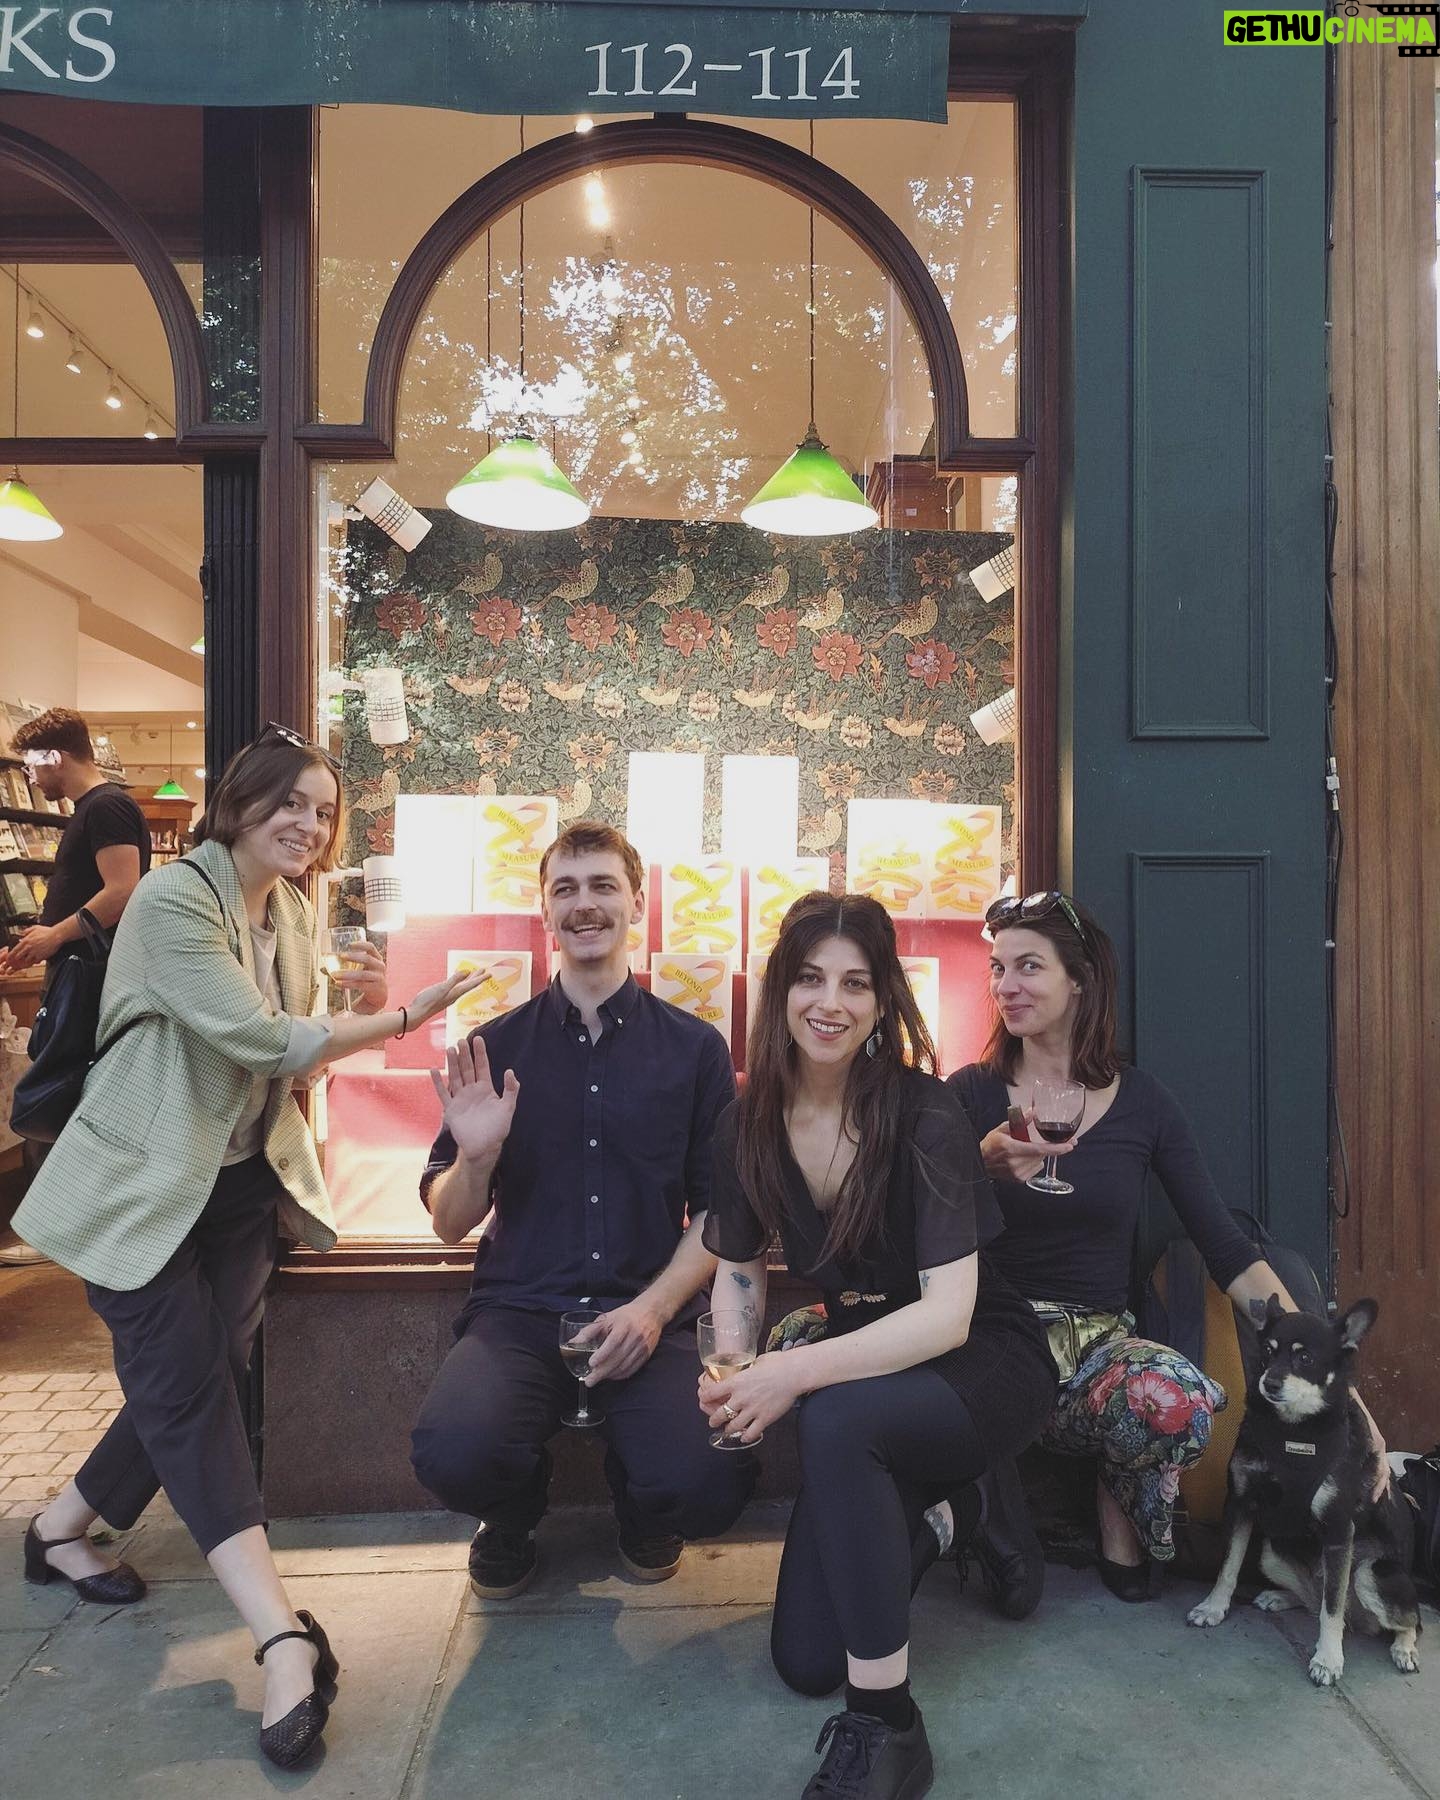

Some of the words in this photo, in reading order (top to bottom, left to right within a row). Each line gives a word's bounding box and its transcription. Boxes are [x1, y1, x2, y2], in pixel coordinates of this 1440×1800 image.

[585, 41, 861, 101] 112-114
[497, 810, 526, 835] BEYOND
[952, 858, 988, 869] MEASURE
[684, 870, 713, 893] BEYOND
[674, 968, 703, 993] BEYOND
